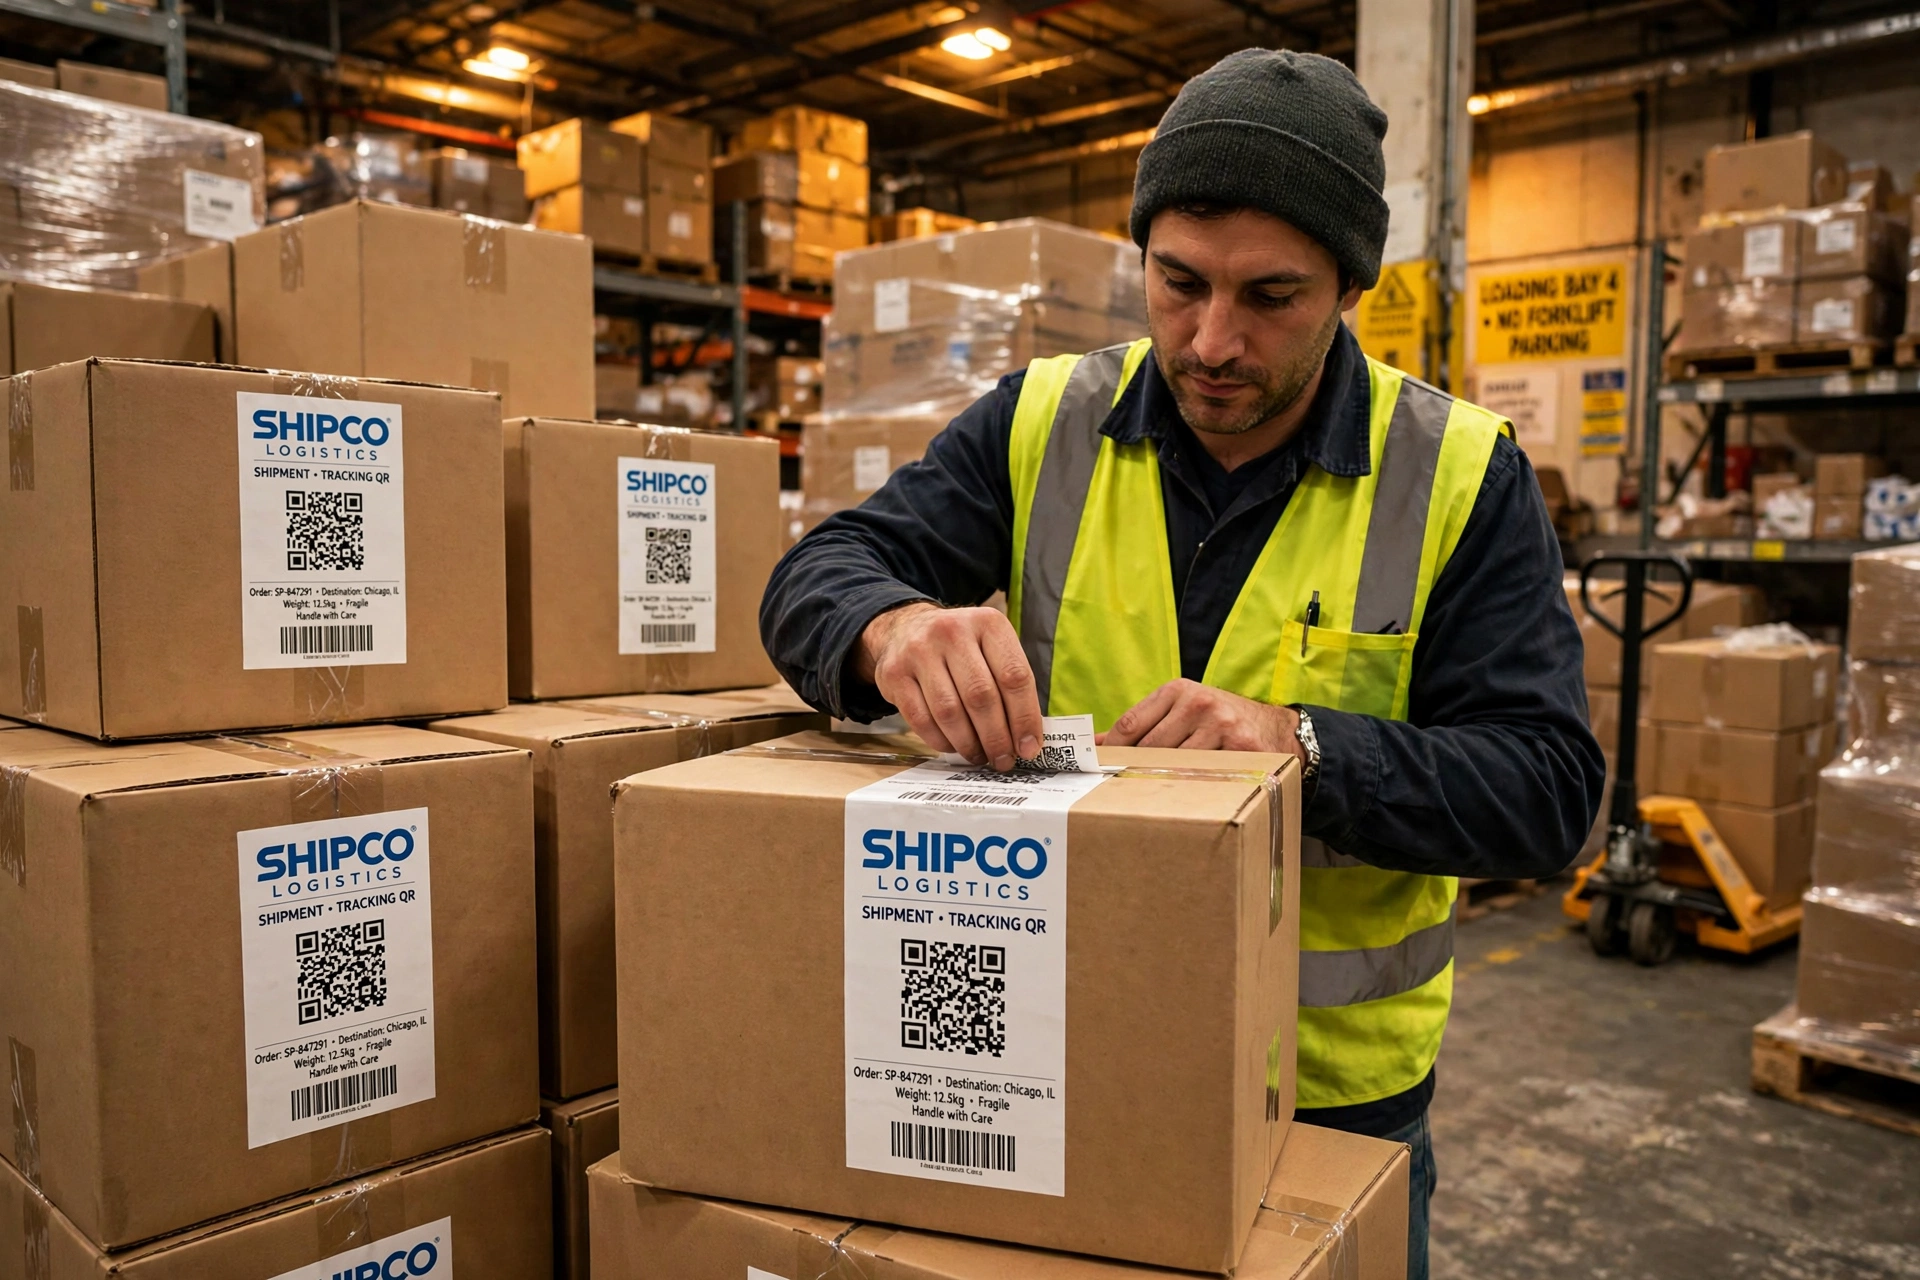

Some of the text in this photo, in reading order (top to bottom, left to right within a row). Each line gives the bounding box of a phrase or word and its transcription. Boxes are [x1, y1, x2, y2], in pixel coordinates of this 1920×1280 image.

[266, 444, 378, 461] LOGISTICS
[254, 467, 390, 484] SHIPMENT TRACKING QR
[634, 495, 701, 506] LOGISTICS
[249, 587, 273, 597] Order:
[321, 586, 362, 596] Destination:
[364, 586, 392, 596] Chicago,
[283, 600, 310, 610] Weight:
[346, 599, 369, 609] Fragile
[296, 611, 357, 620] Handle with Care
[273, 867, 401, 898] LOGISTICS
[878, 875, 1029, 901] LOGISTICS
[258, 889, 415, 926] SHIPMENT TRACKING QR
[862, 905, 1047, 935] SHIPMENT TRACKING QR
[255, 1016, 427, 1065] Order: SP-847291 Destination: Chicago, IL
[294, 1038, 392, 1069] Weight: 12.5kg Fragile
[309, 1055, 379, 1079] Handle with Care
[853, 1066, 1056, 1100] Order: SP-847291 Destination: Chicago, IL
[895, 1086, 1010, 1112] Weight: 12.5kg Fragile
[912, 1105, 993, 1125] Handle with Care
